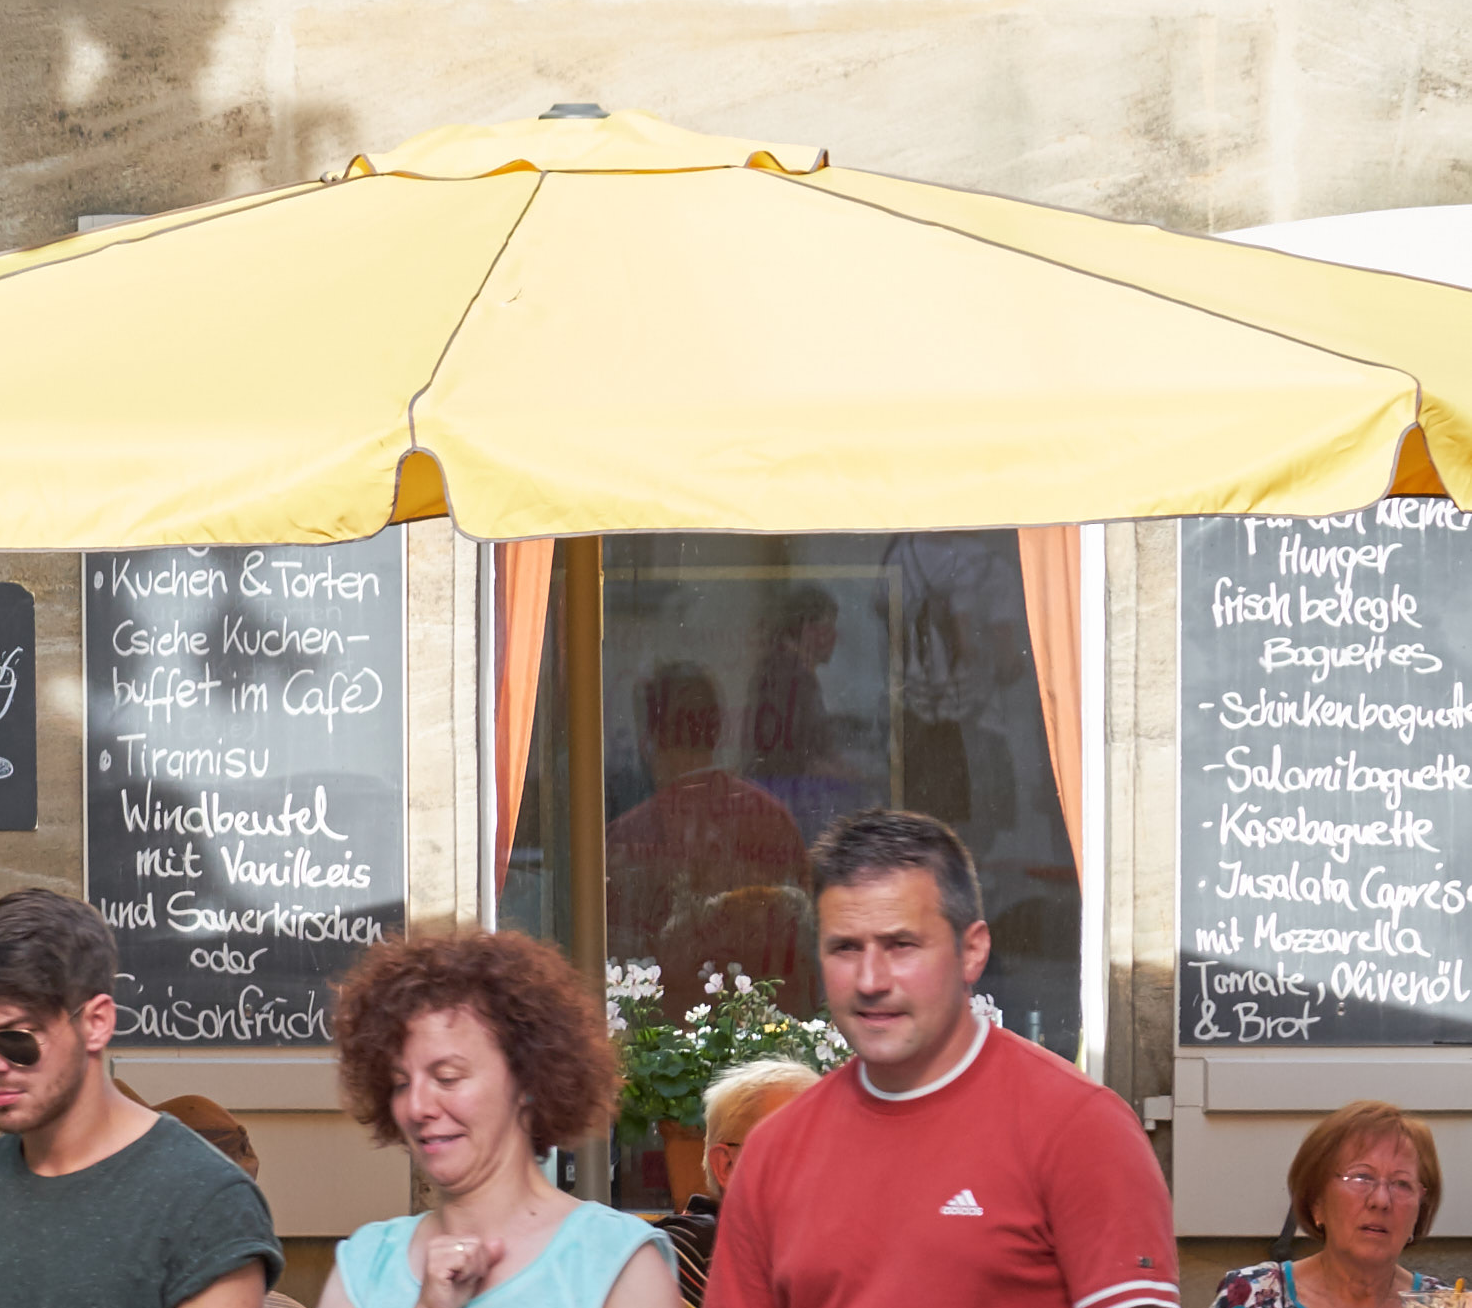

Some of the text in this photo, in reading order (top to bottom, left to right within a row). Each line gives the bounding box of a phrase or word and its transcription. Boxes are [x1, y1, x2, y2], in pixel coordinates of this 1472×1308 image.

[112, 550, 381, 603] Kuchen & Torten
[1279, 532, 1404, 597] Hunger
[1213, 576, 1424, 633] frisch belegte
[1258, 635, 1444, 684] Baguettes
[112, 661, 223, 724] buffet
[231, 670, 269, 715] im
[116, 732, 270, 779] Tiramisu
[1225, 744, 1472, 811] Salamibaguette
[121, 780, 349, 841] Windbeutel
[1218, 801, 1441, 863] Käsebaguette
[135, 843, 372, 890] mit Vanilleeis
[1215, 859, 1359, 912] Insalata
[99, 890, 389, 946] und Sauerkirschen
[1195, 911, 1432, 958] mit Mozzarella
[190, 942, 269, 975] oder
[1331, 958, 1471, 1006] Olivenöl
[113, 972, 335, 1042] Saisonfrüch
[1193, 998, 1322, 1043] & Brot
